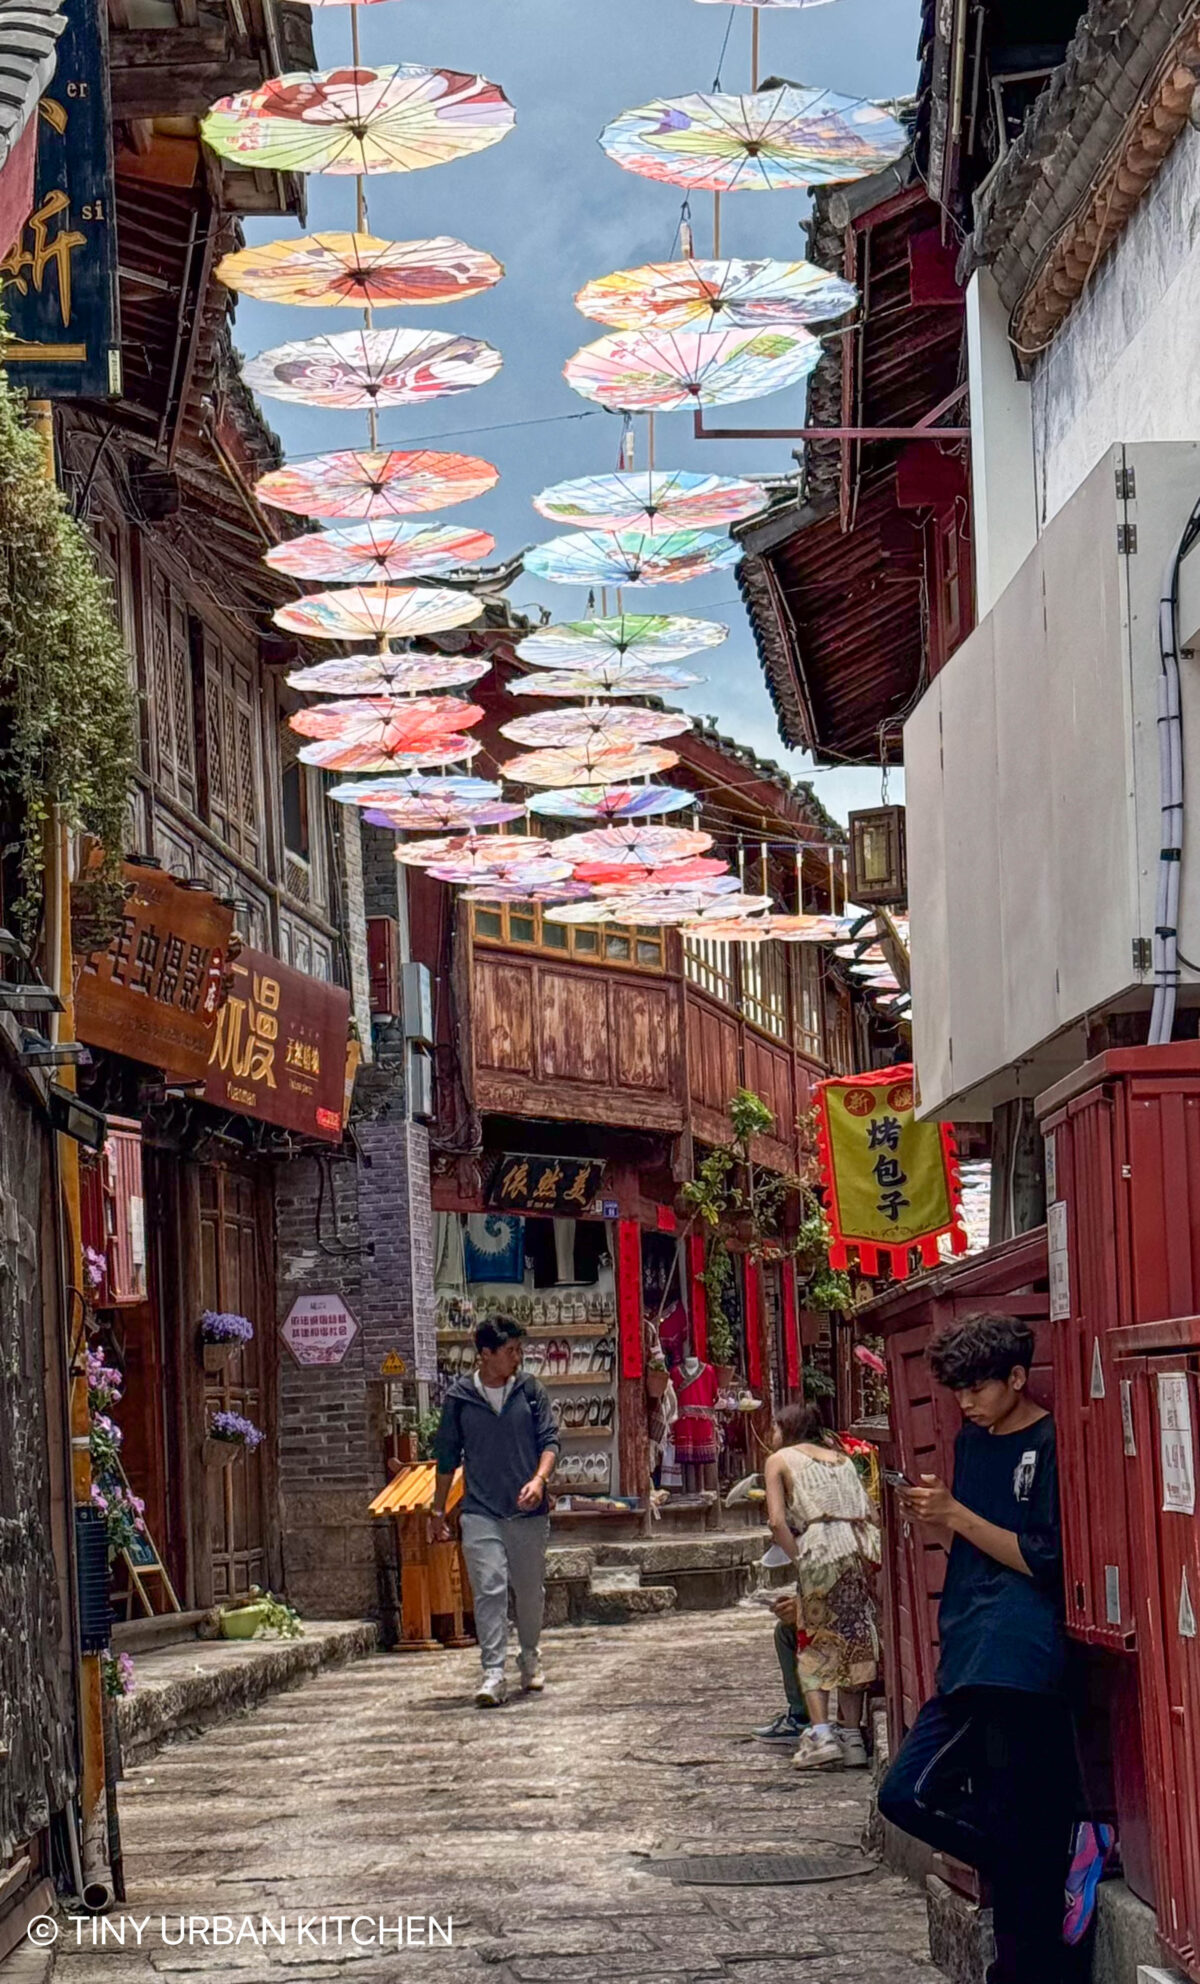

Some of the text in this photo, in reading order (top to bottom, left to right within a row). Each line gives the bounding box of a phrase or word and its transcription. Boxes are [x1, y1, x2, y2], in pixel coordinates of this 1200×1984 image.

[81, 201, 105, 221] si
[866, 1116, 910, 1222] 烤包子
